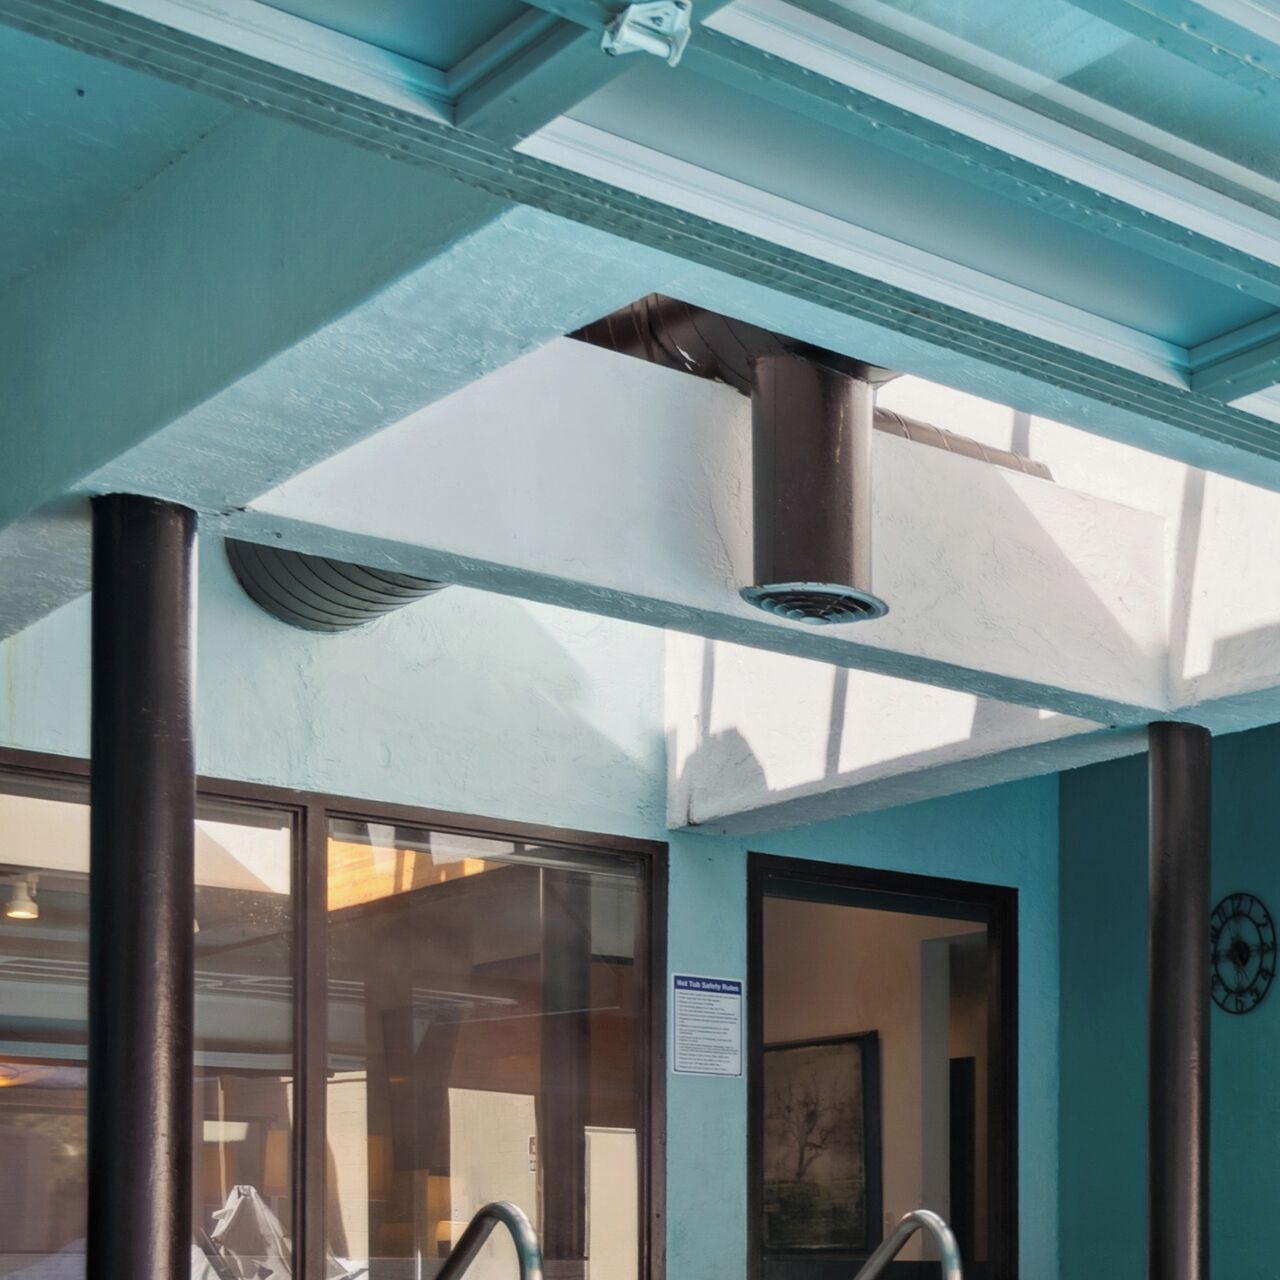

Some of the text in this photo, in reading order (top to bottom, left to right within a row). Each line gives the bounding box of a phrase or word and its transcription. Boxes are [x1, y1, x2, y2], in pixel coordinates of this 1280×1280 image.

[689, 980, 701, 988] Tub
[702, 981, 721, 991] Safety
[722, 984, 739, 992] Rules
